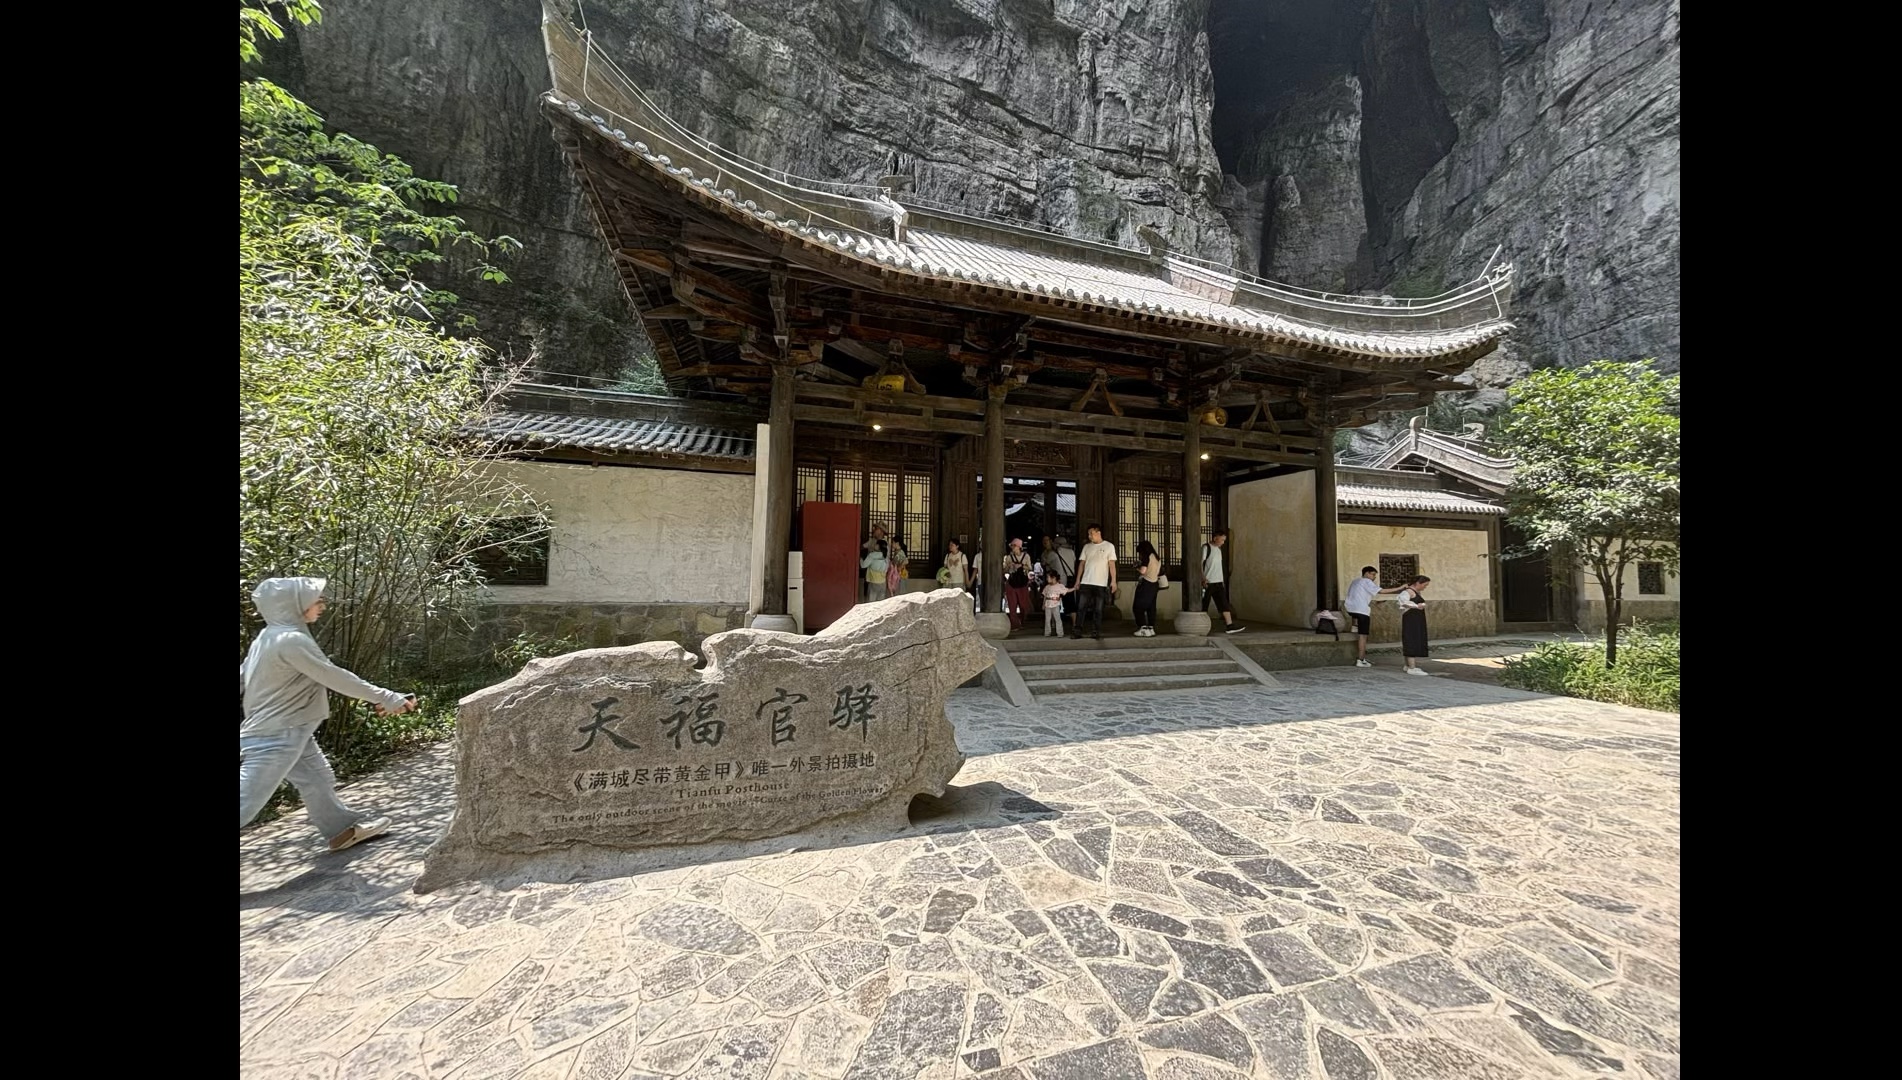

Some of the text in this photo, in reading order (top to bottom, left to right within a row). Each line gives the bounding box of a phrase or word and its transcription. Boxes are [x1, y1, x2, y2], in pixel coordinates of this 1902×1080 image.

[572, 683, 879, 752] 天福官驿
[573, 751, 875, 792] 《满城尽带黄金甲》唯一外景拍摄地
[677, 783, 789, 798] Tianfu Posthouse
[552, 814, 575, 824] The
[578, 812, 602, 822] only
[606, 808, 650, 819] outdoor
[652, 806, 681, 815] scene
[684, 802, 695, 811] of
[819, 788, 850, 798] Golden
